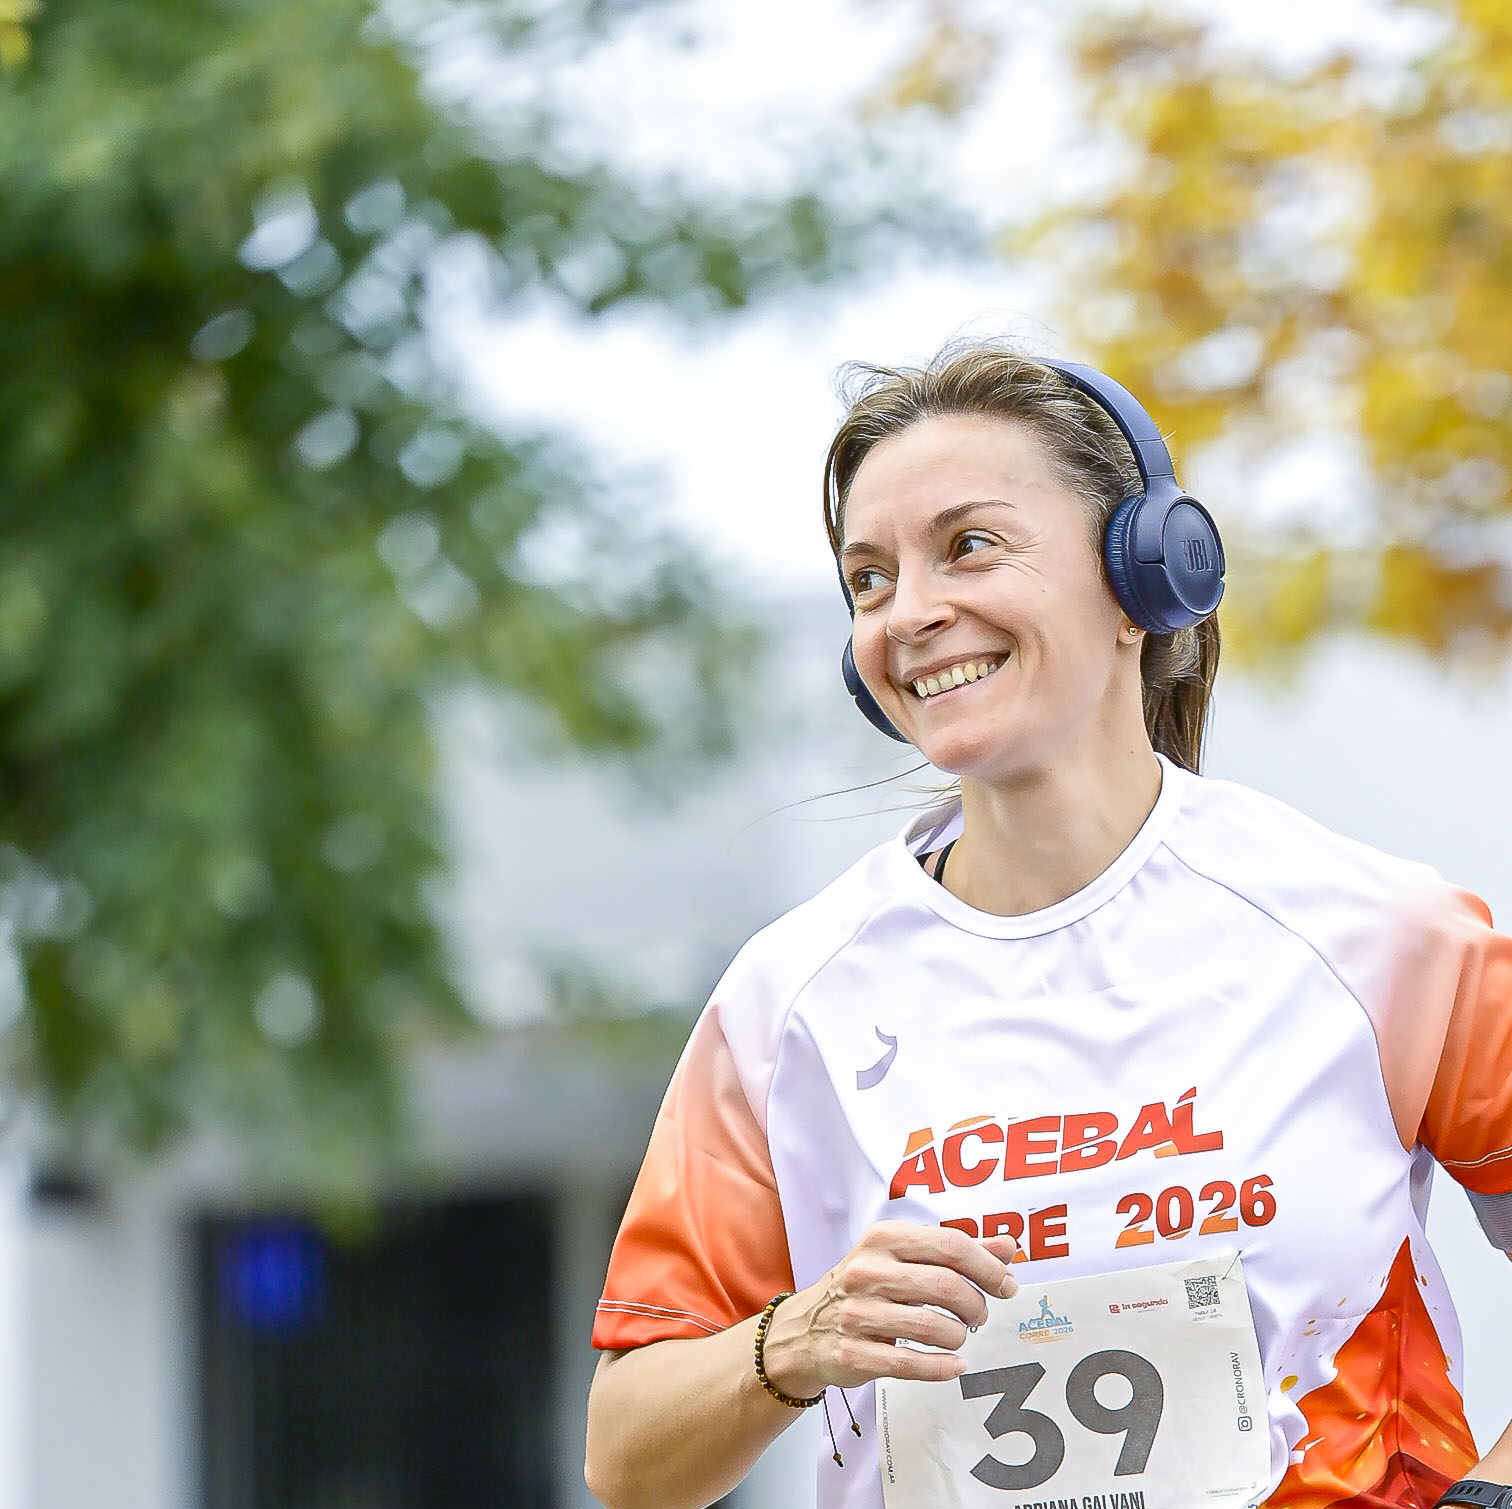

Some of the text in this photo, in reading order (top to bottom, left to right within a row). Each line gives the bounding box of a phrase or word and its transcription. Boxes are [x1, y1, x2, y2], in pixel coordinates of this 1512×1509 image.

[1180, 538, 1214, 573] JBL
[1115, 1174, 1277, 1249] 2026
[1229, 1351, 1248, 1414] @CRONORAV
[959, 1349, 1165, 1491] 39
